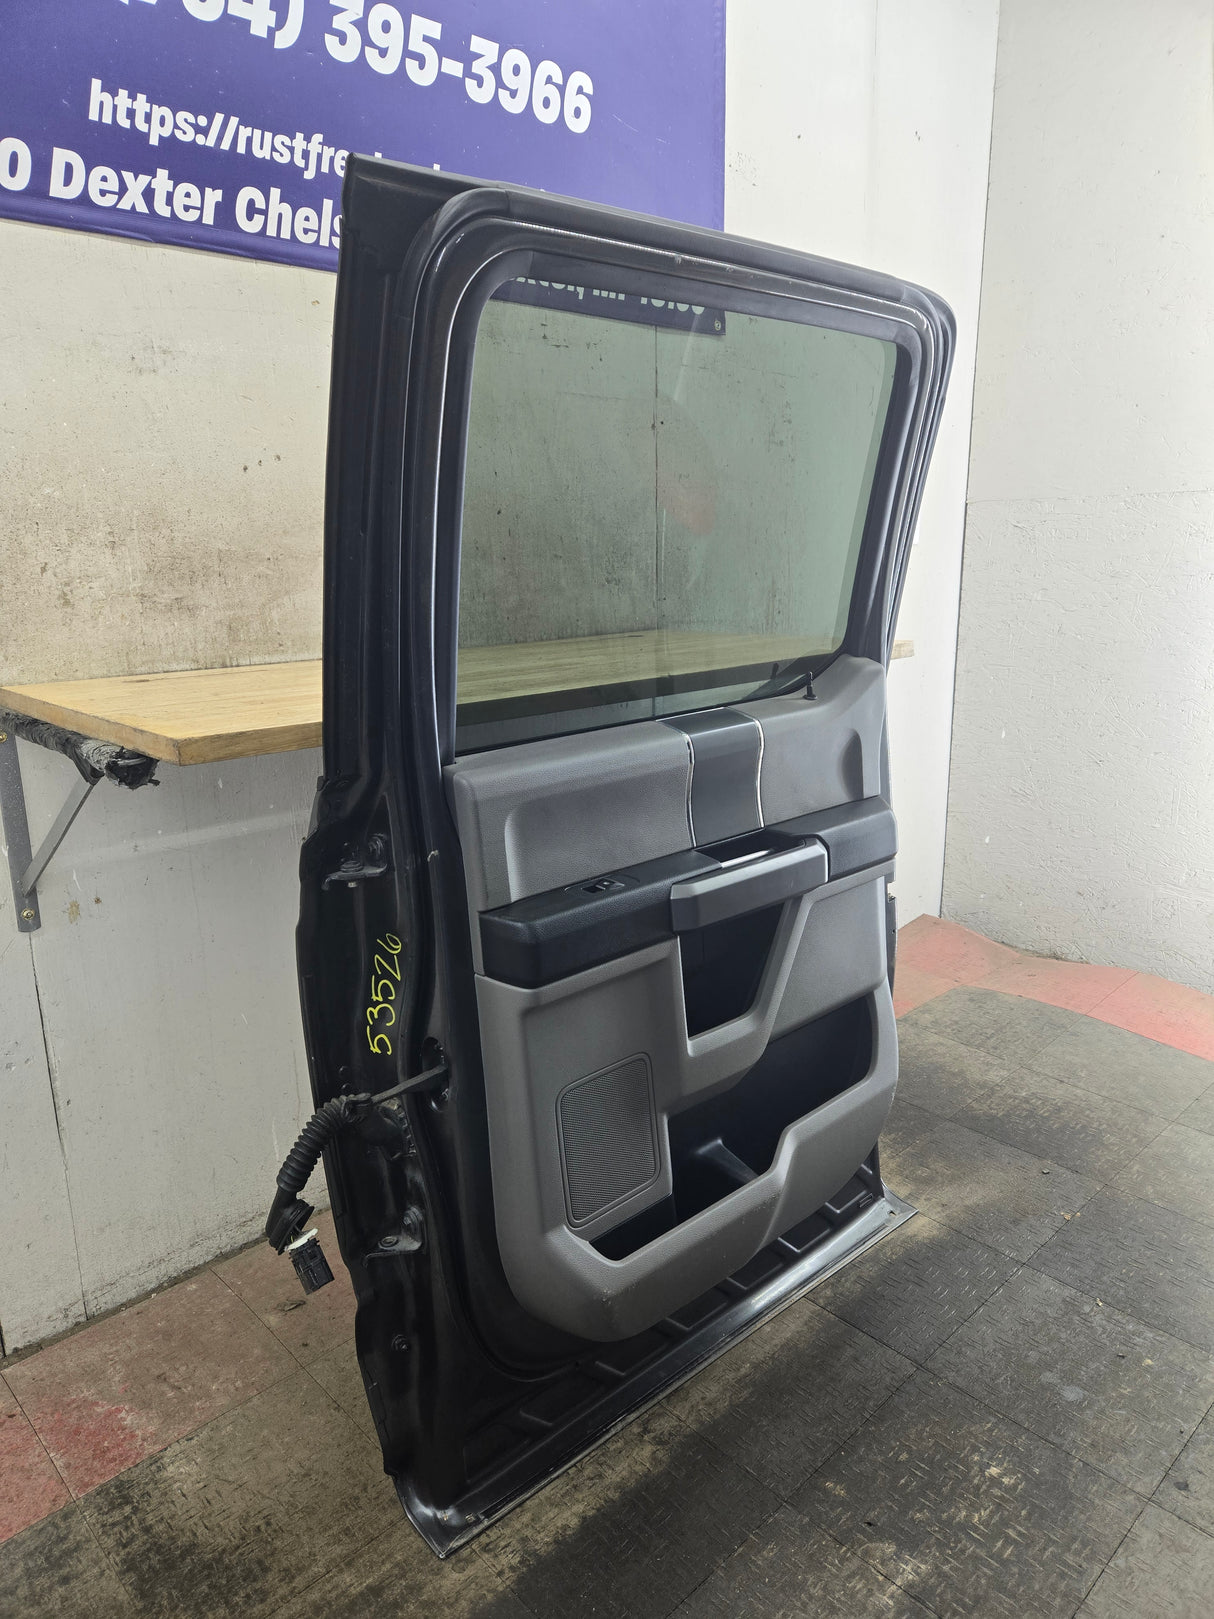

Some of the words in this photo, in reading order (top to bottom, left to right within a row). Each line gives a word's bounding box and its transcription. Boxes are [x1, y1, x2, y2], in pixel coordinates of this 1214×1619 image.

[324, 0, 594, 134] 395-3966
[88, 77, 382, 180] https://rustfre
[49, 146, 223, 225] Dexter
[366, 933, 402, 1056] 53526
